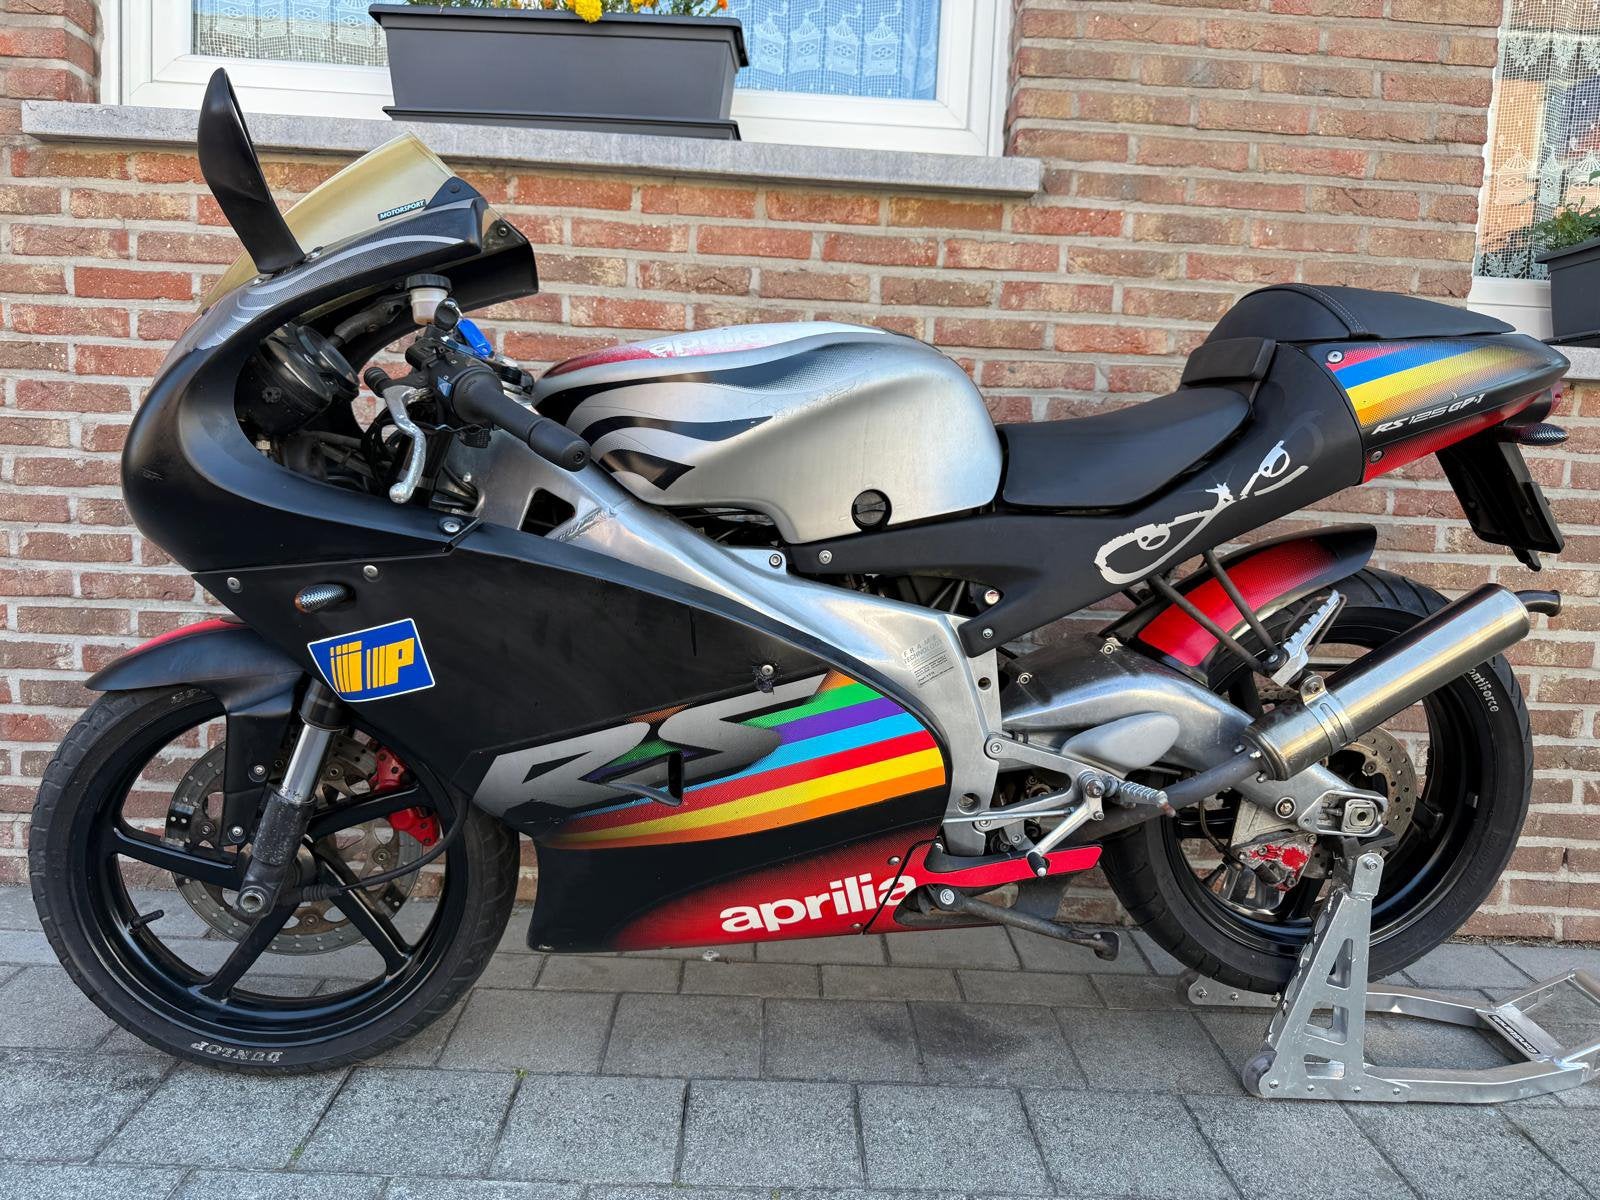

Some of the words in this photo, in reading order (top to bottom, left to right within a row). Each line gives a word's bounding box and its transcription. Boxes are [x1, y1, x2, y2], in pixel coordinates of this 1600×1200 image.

[379, 200, 425, 219] MOTORSPORT
[1371, 417, 1409, 435] RS
[1408, 405, 1449, 424] 125
[1468, 668, 1499, 711] ontiForce
[472, 672, 828, 817] RS
[719, 872, 917, 932] aprilia
[190, 1041, 283, 1063] DUNLOP
